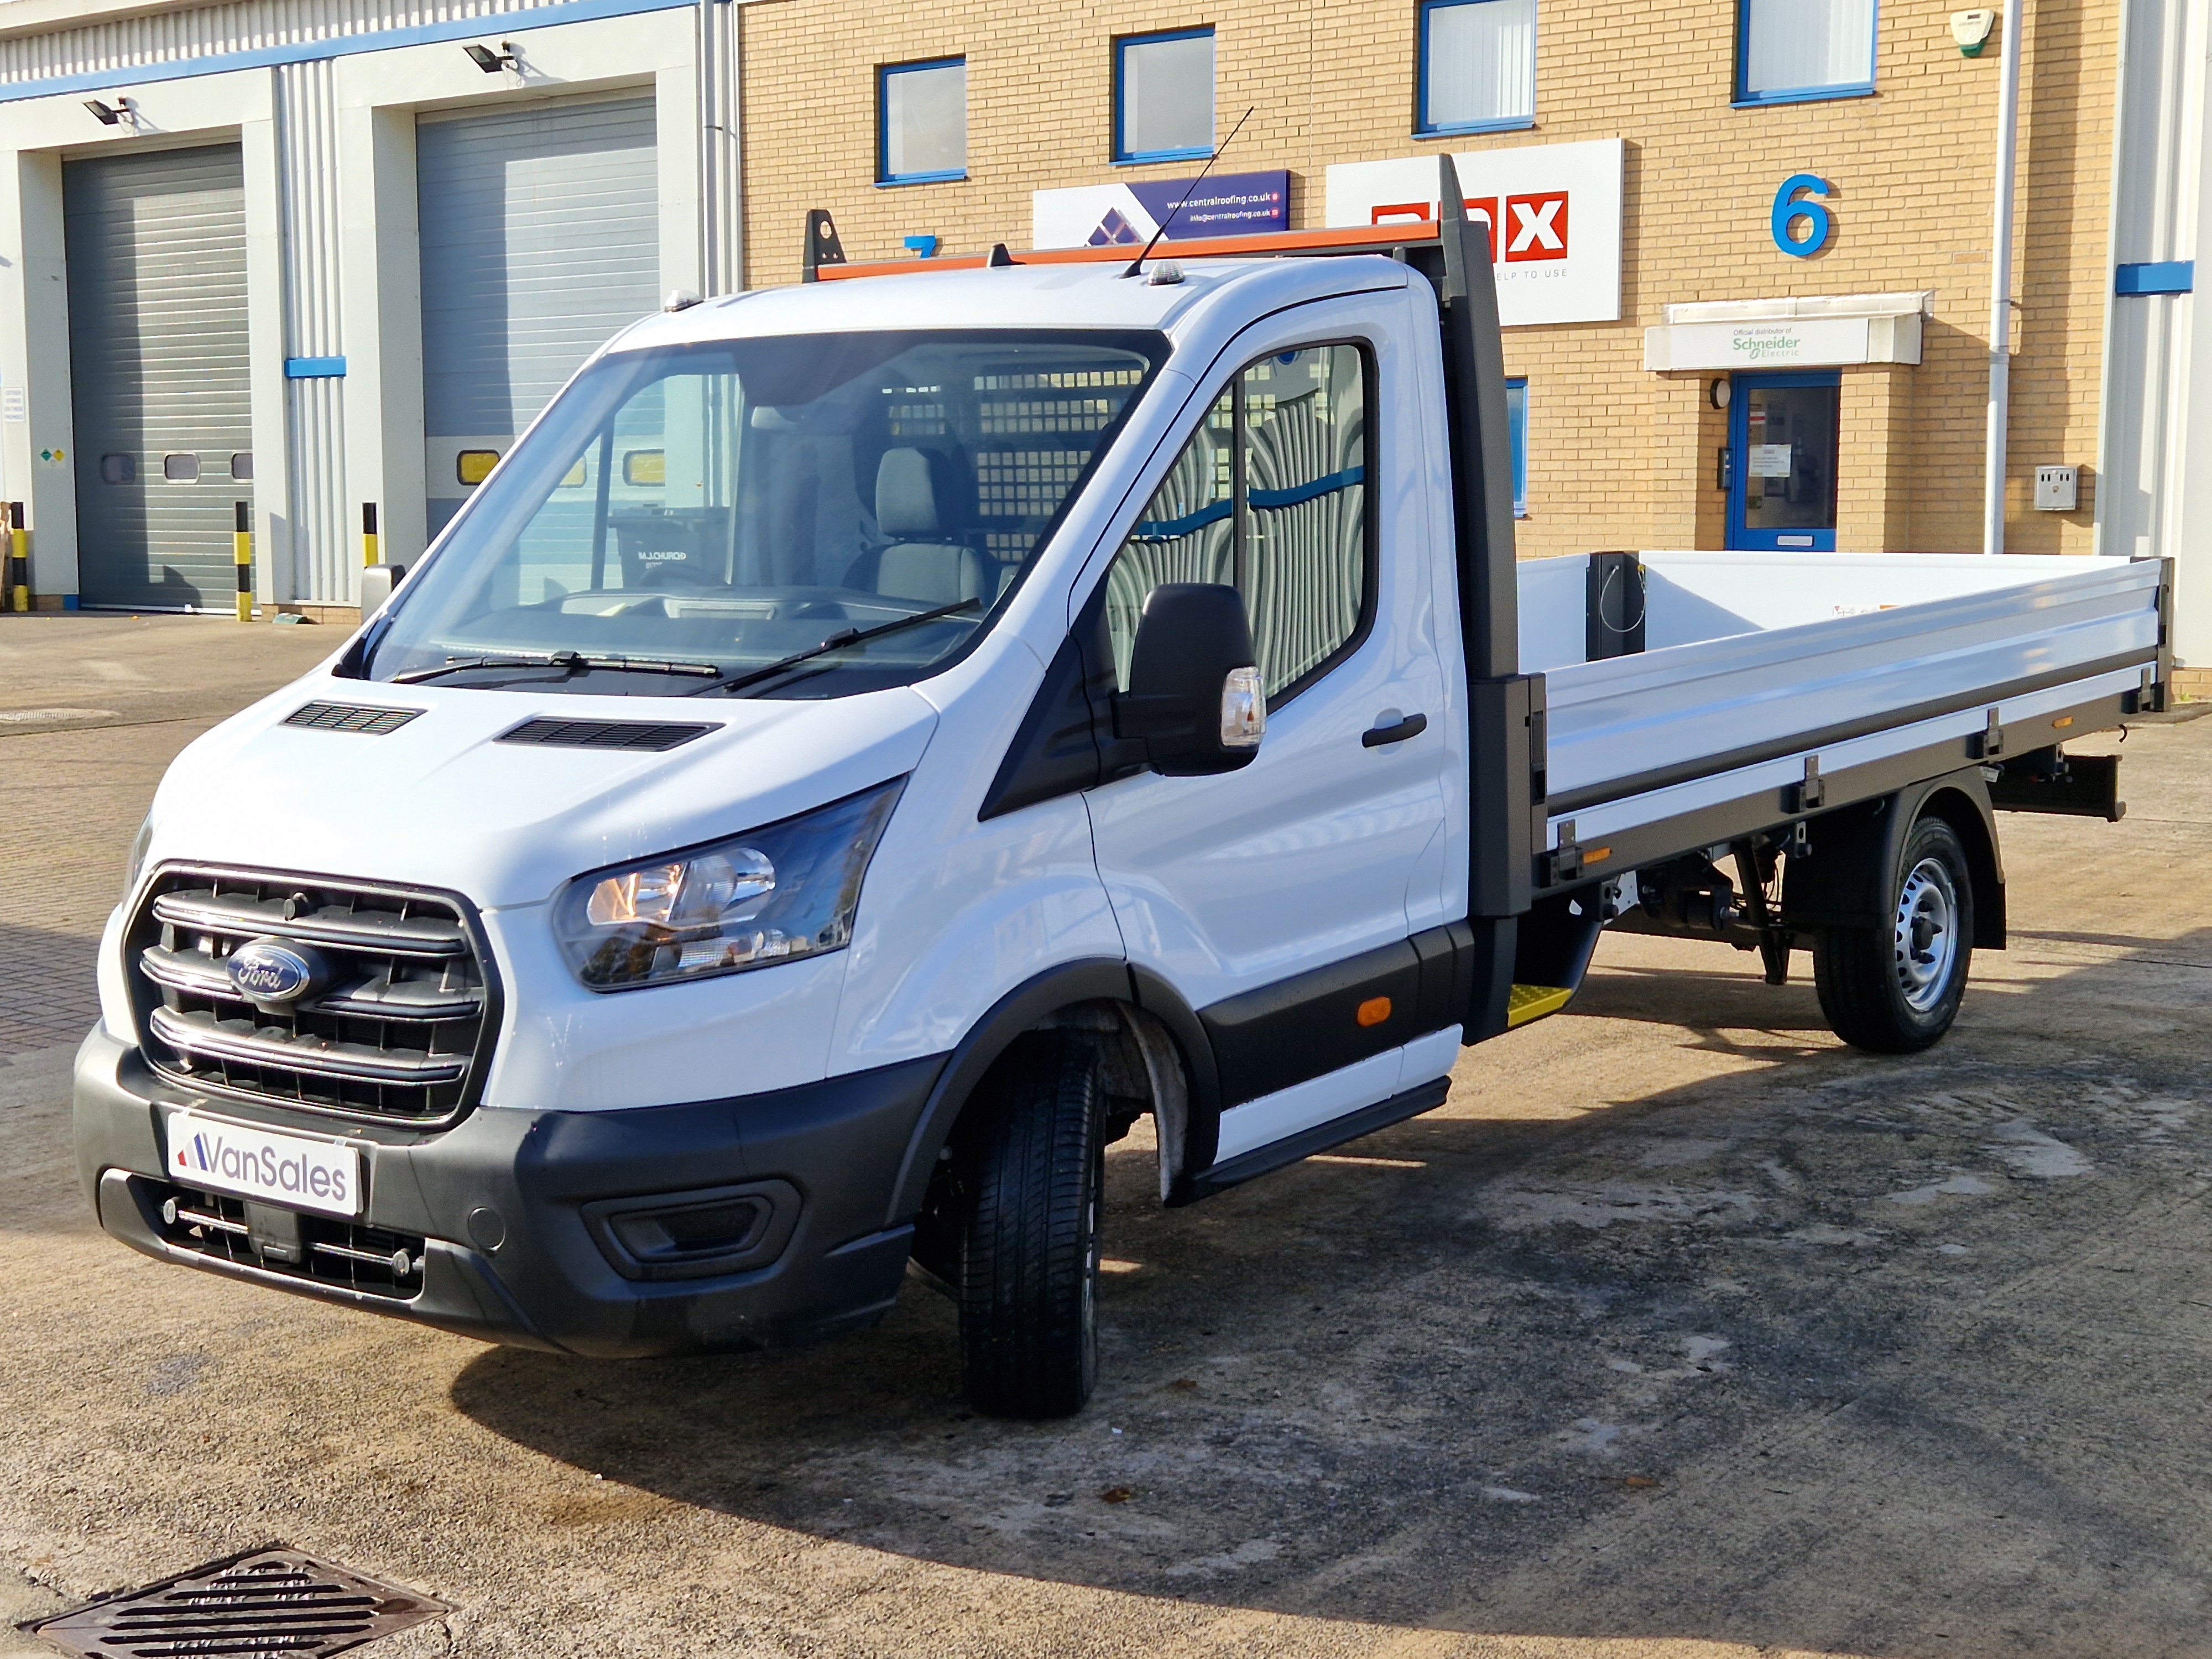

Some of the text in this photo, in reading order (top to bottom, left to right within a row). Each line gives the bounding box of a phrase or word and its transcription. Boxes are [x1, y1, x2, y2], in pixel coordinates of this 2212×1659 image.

[1167, 192, 1271, 209] www.centralroofing.co.uk
[1771, 173, 1830, 257] 6
[1496, 268, 1567, 281] ELP TO USE
[1733, 335, 1801, 350] Schneider
[1761, 349, 1799, 358] Electric
[237, 955, 284, 990] Ford
[202, 1131, 346, 1202] VanSales
